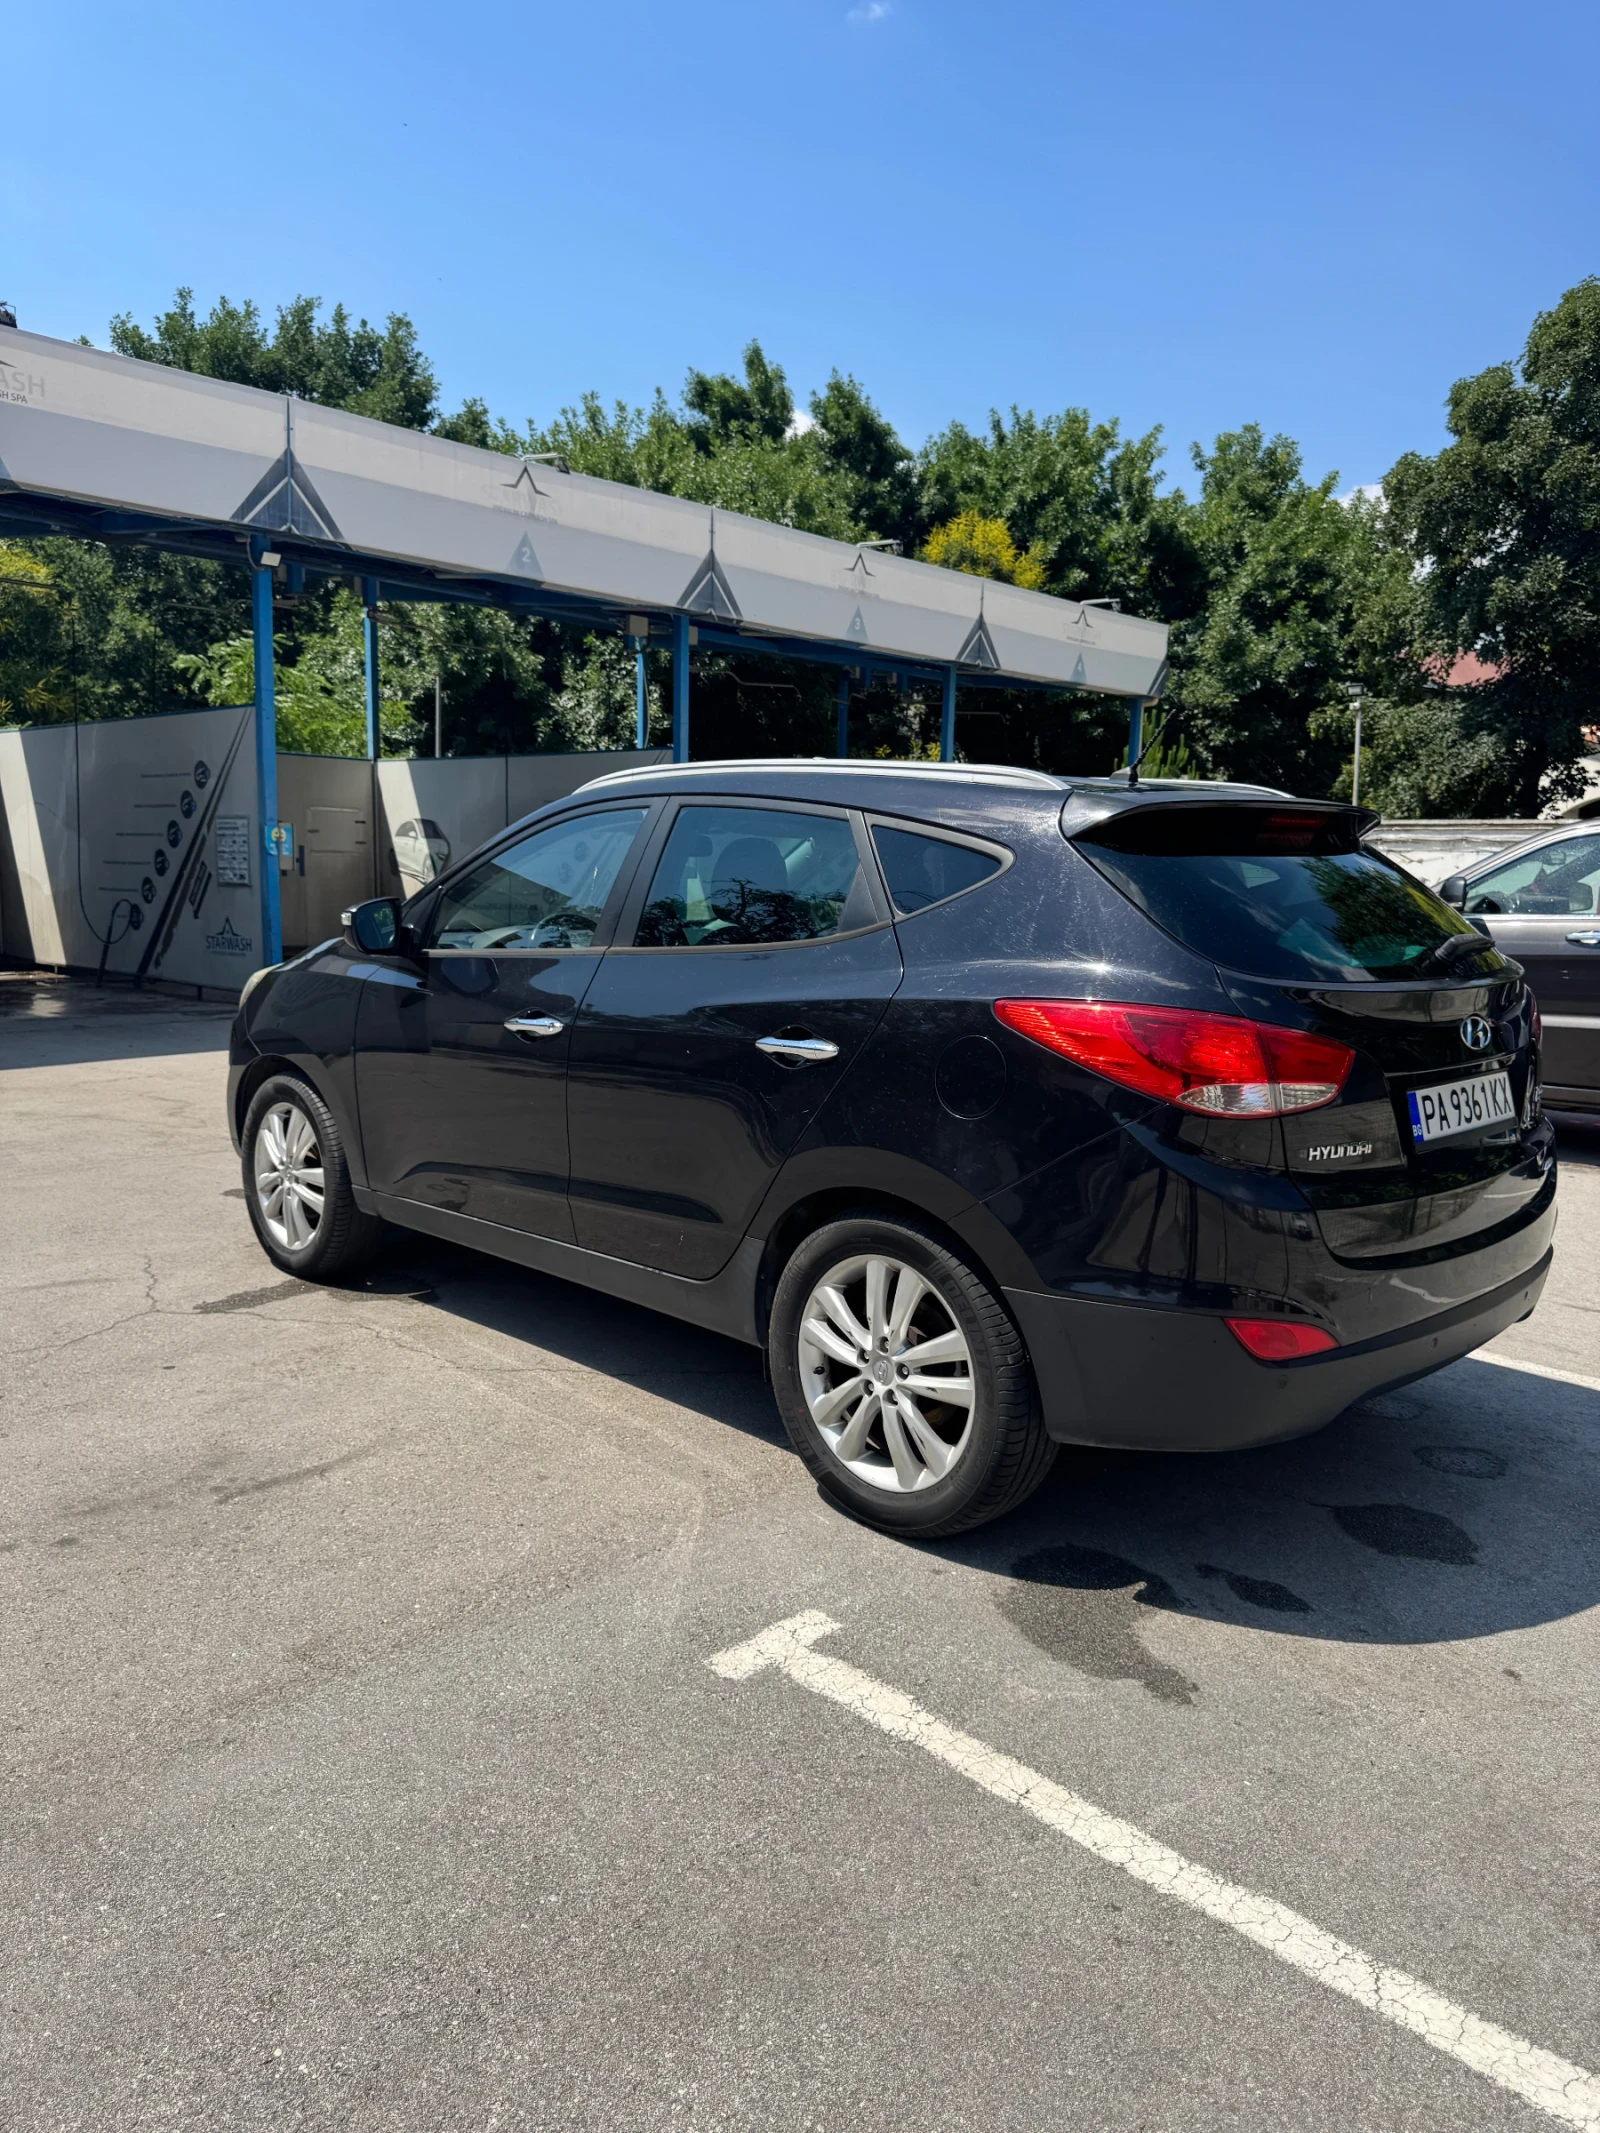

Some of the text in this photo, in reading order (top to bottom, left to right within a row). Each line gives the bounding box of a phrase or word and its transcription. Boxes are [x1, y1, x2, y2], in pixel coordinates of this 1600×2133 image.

[11, 392, 28, 404] SPA
[521, 547, 532, 562] 2
[854, 617, 861, 631] 3
[205, 935, 253, 952] STARWASH
[1412, 1124, 1423, 1137] BG
[1308, 1141, 1373, 1161] HYUNDAI
